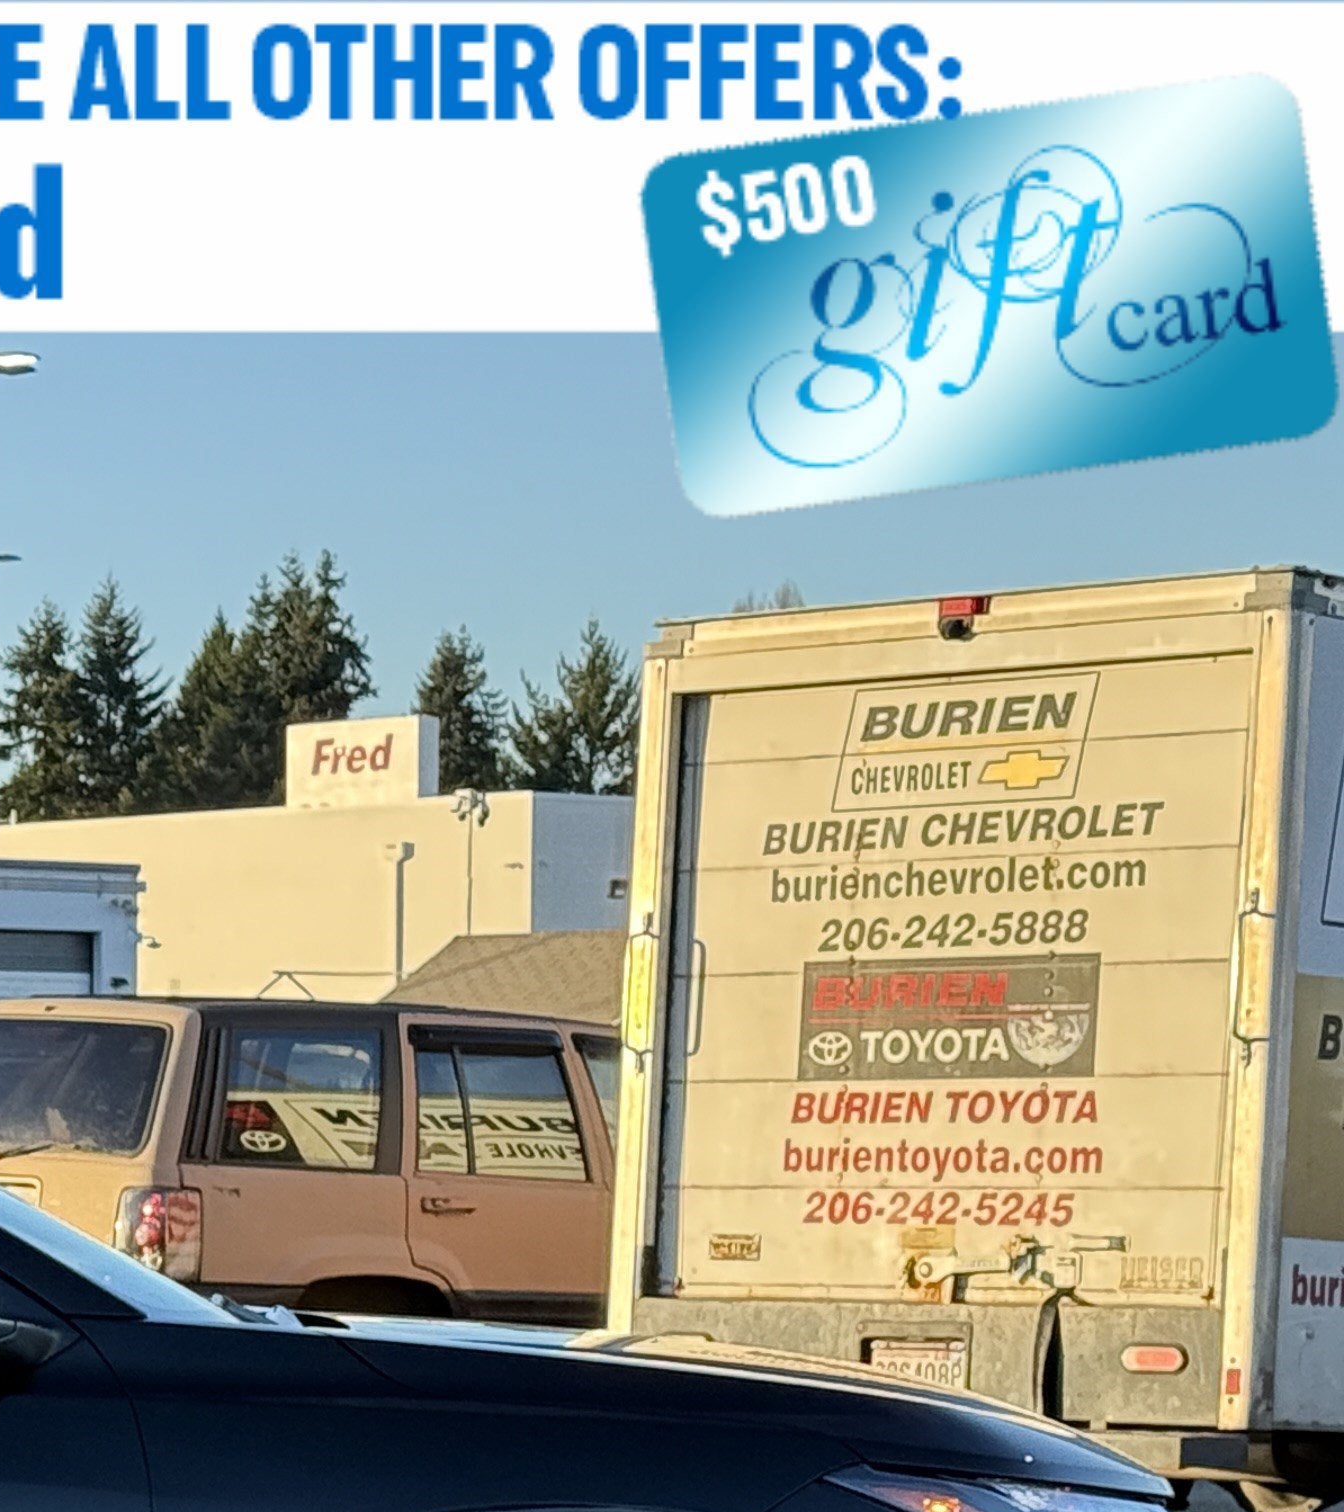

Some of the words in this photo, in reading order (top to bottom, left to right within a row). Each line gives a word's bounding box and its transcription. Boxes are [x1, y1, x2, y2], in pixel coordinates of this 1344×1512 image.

[860, 691, 1078, 743] BURIEN
[310, 732, 394, 777] Fred
[851, 760, 972, 796] CHEVROLET
[761, 814, 910, 857] BURIEN
[920, 801, 1165, 849] CHEVROLET
[770, 855, 1146, 903] burienchevrolet.com
[812, 971, 1009, 1011] BURIEN
[859, 1027, 1011, 1064] TOYOTA
[790, 1091, 934, 1124] BURIEN
[945, 1089, 1099, 1124] TOYOTA
[783, 1137, 1104, 1182] burientoyota.com
